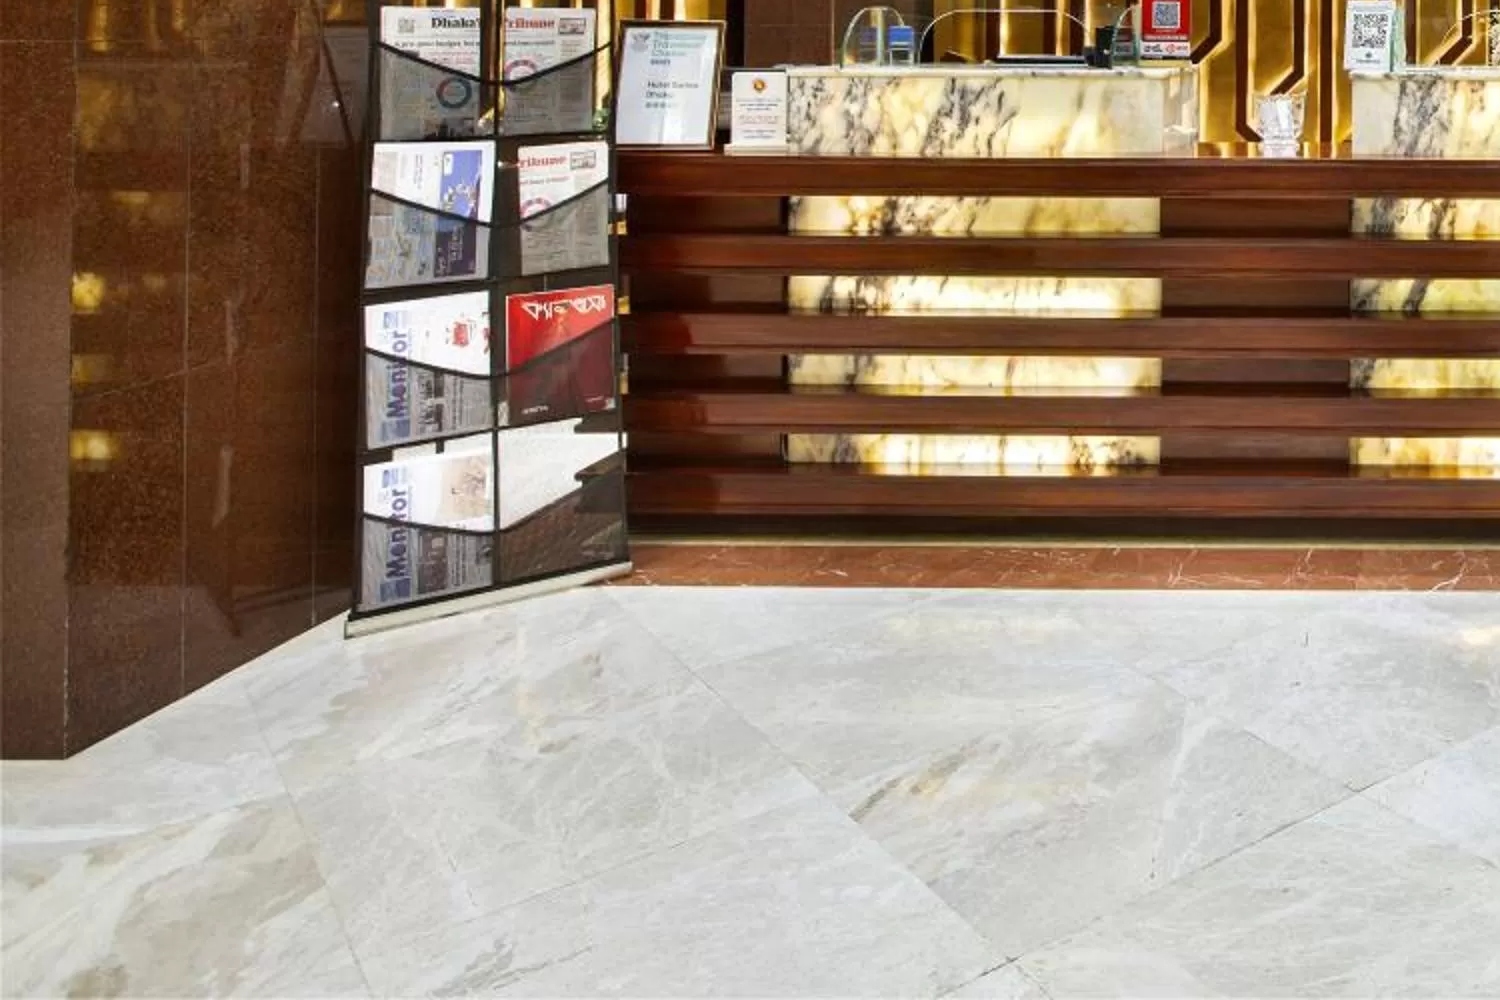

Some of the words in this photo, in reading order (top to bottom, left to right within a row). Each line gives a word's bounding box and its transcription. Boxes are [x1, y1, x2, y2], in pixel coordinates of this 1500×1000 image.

[431, 17, 476, 29] Dhaka
[386, 330, 408, 418] Monior
[385, 487, 408, 579] Montor
